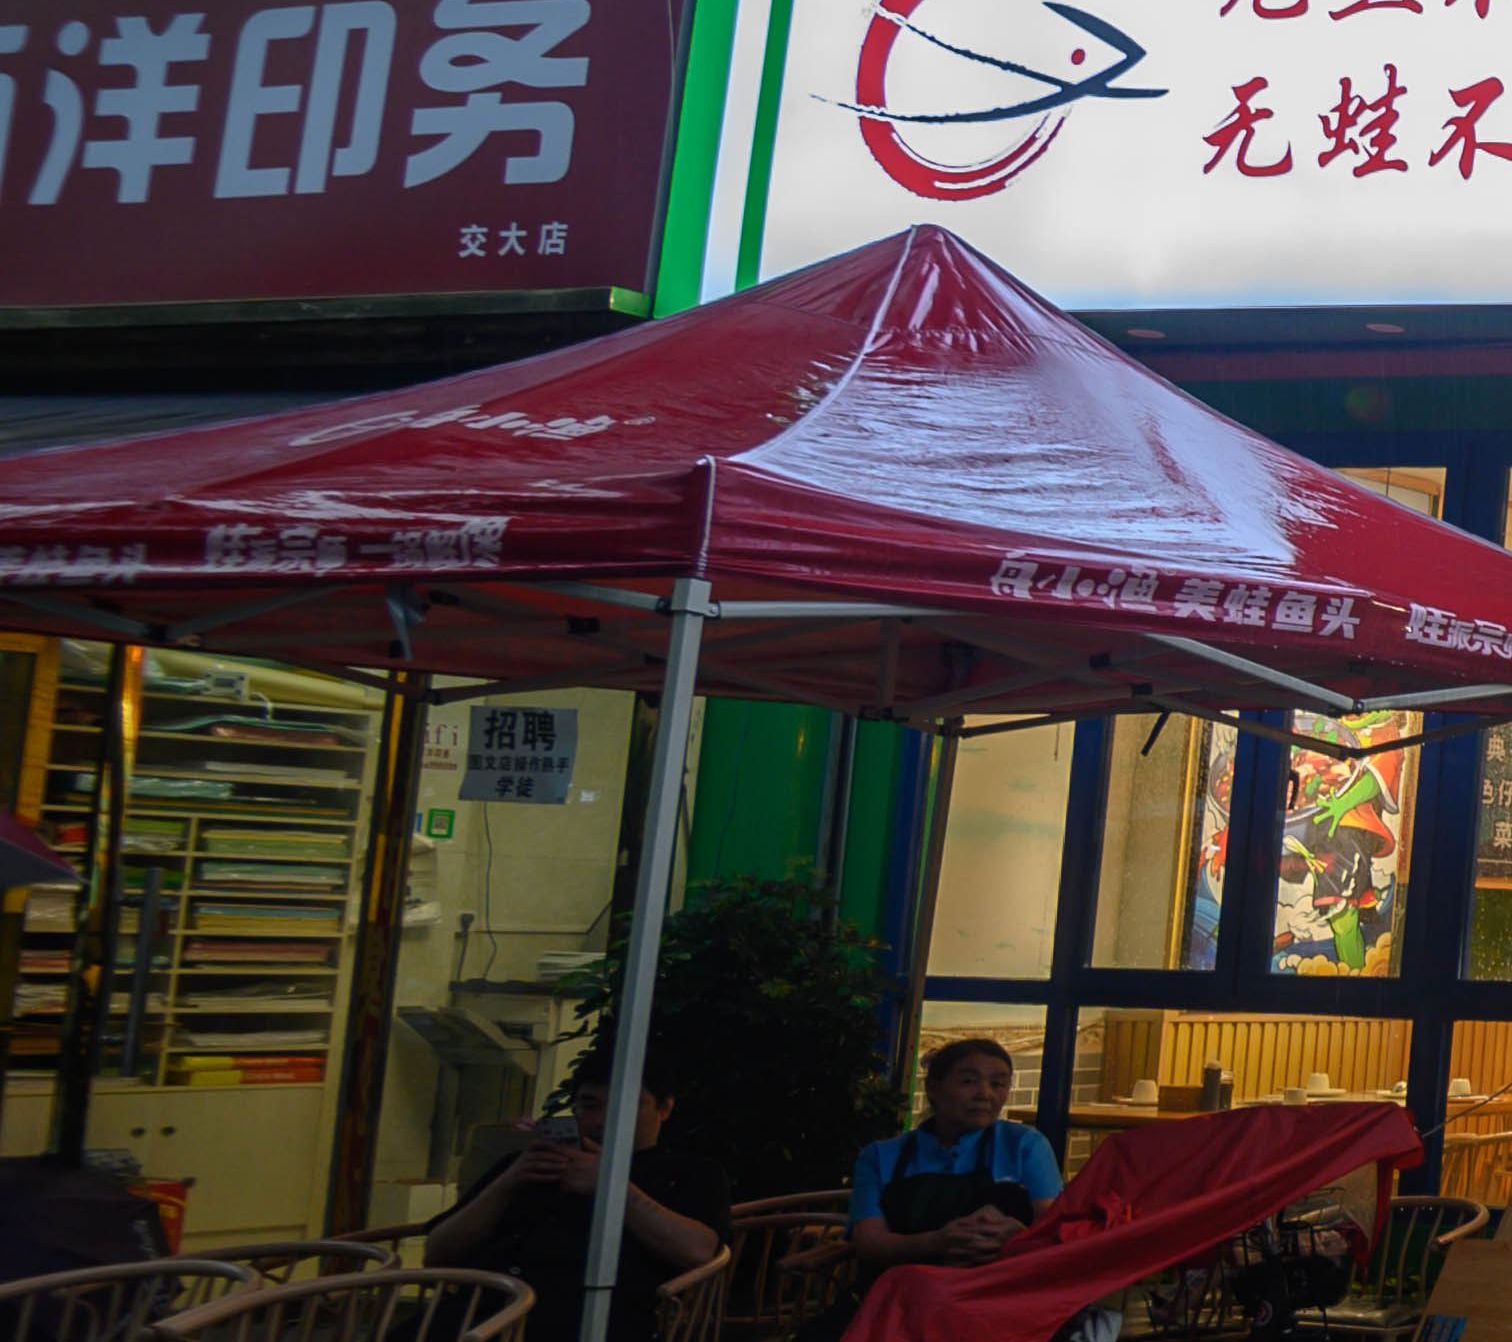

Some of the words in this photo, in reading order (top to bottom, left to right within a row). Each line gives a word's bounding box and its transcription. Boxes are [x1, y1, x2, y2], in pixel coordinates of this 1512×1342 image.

[460, 221, 568, 258] 交大店
[1172, 577, 1361, 640] 美蛙鱼头
[484, 710, 557, 751] 招聘
[495, 776, 535, 798] 学徒
